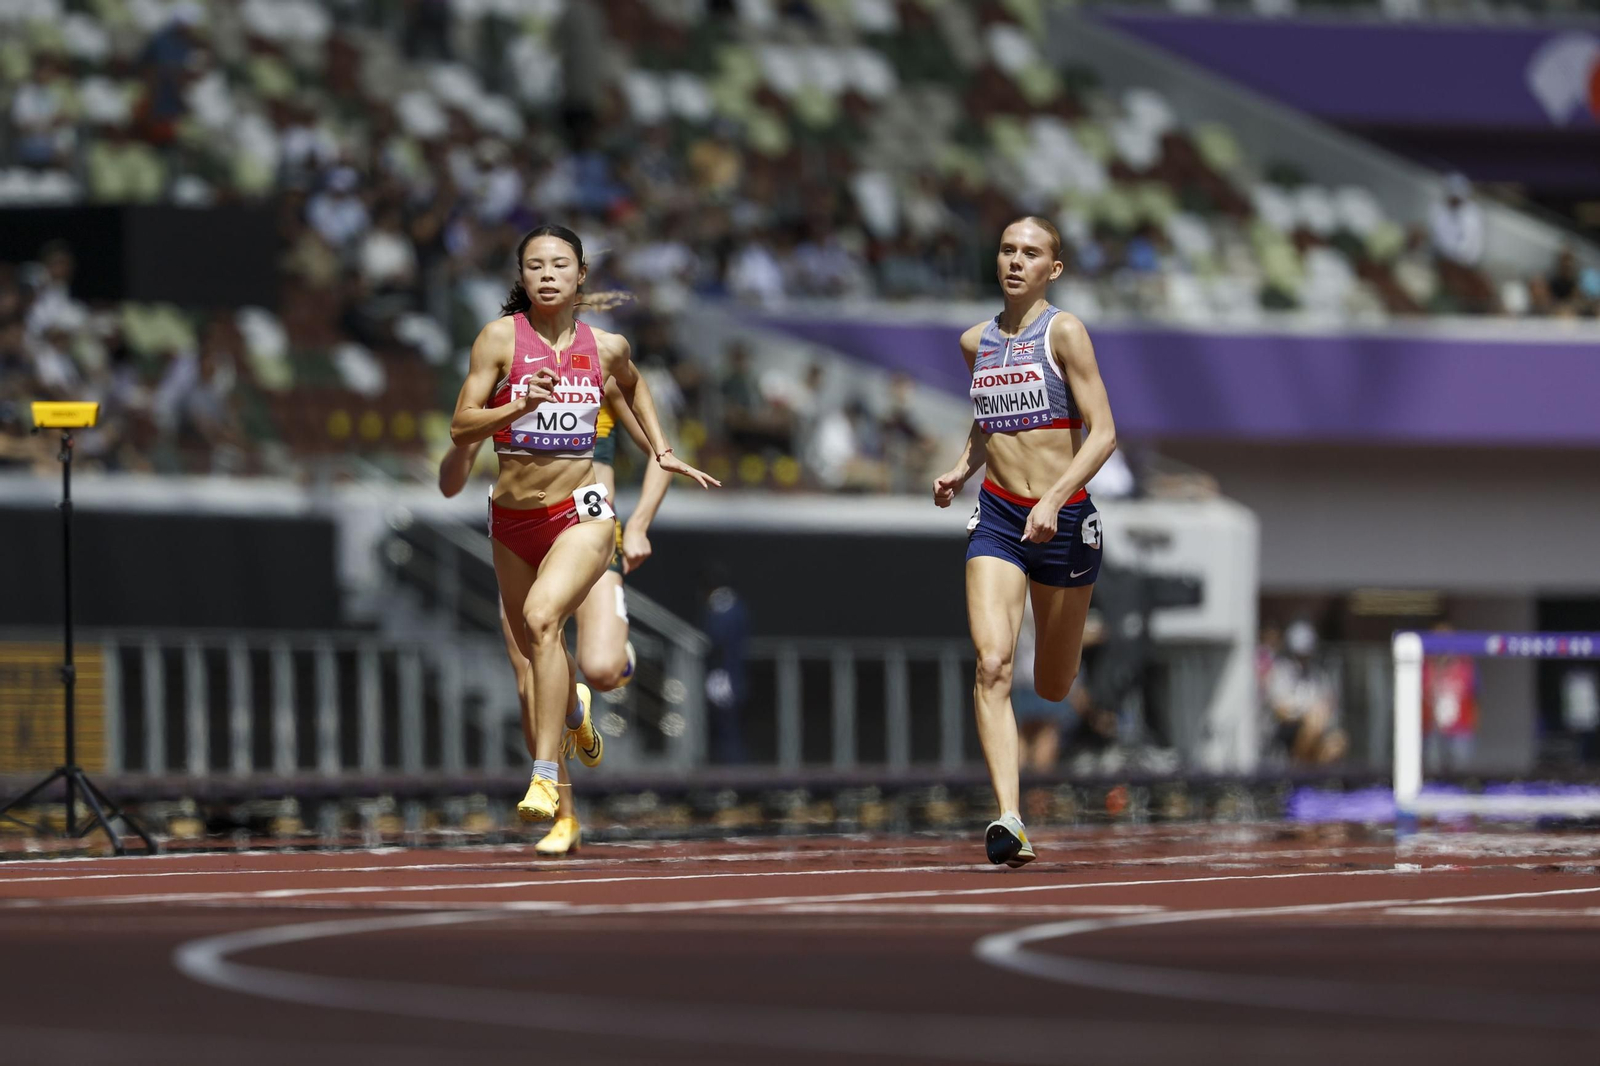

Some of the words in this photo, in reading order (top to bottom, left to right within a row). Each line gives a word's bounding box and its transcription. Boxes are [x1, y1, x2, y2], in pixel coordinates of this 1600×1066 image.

[972, 370, 1042, 389] HONDA
[514, 391, 598, 404] HNDA
[974, 389, 1045, 416] NEWNHAM
[537, 412, 578, 431] MO
